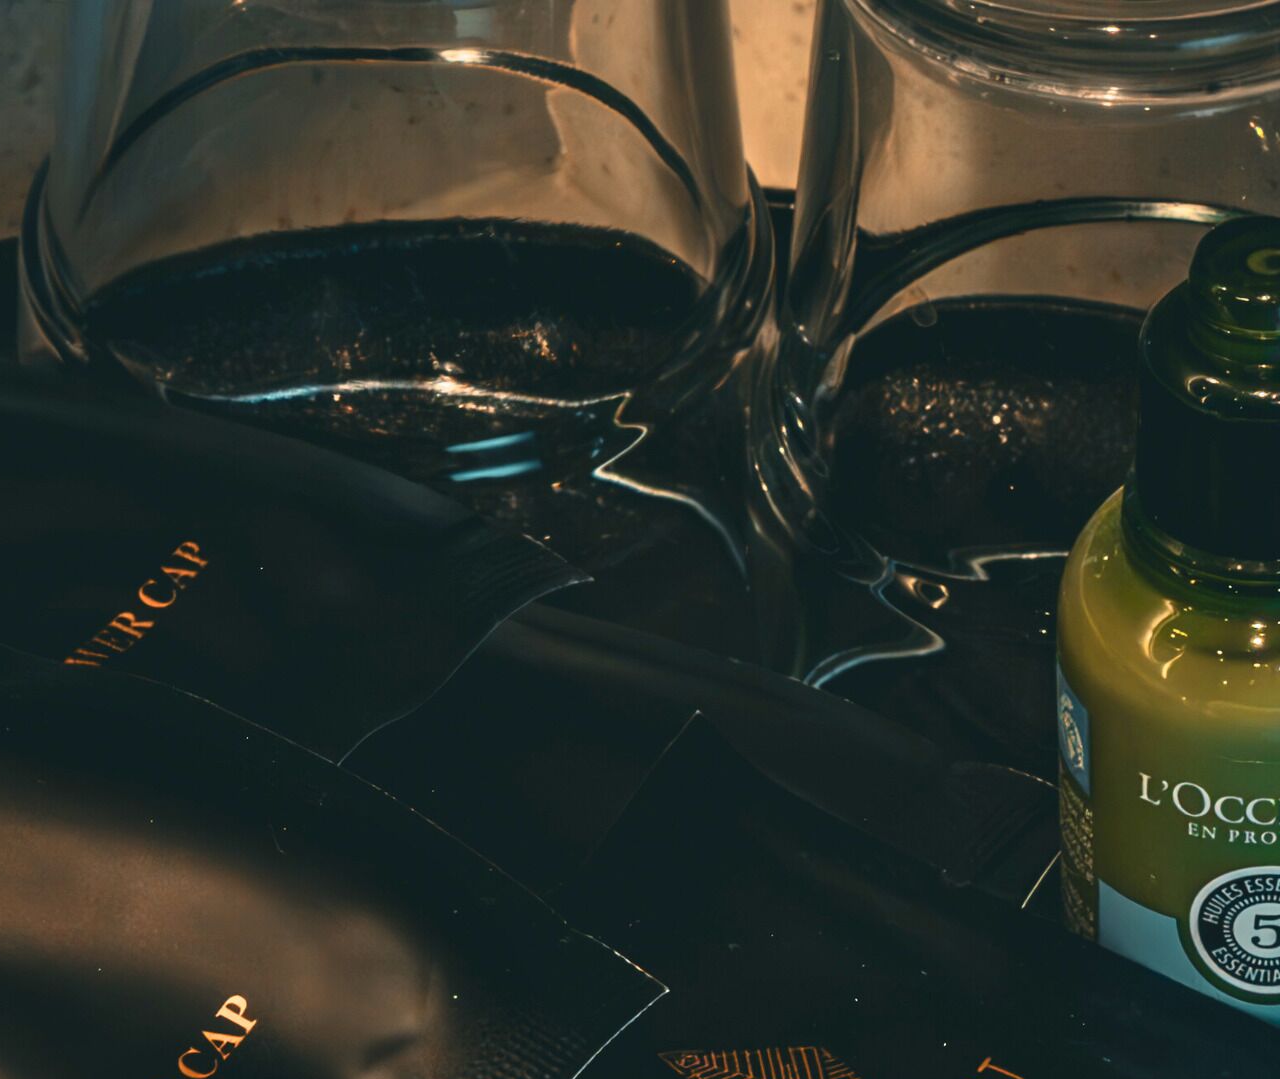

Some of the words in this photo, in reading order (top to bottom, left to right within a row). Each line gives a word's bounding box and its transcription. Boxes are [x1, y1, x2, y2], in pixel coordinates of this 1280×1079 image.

[137, 540, 209, 609] CAP
[1188, 822, 1216, 840] EN
[1202, 883, 1244, 925] HUILES
[177, 993, 258, 1079] CAP
